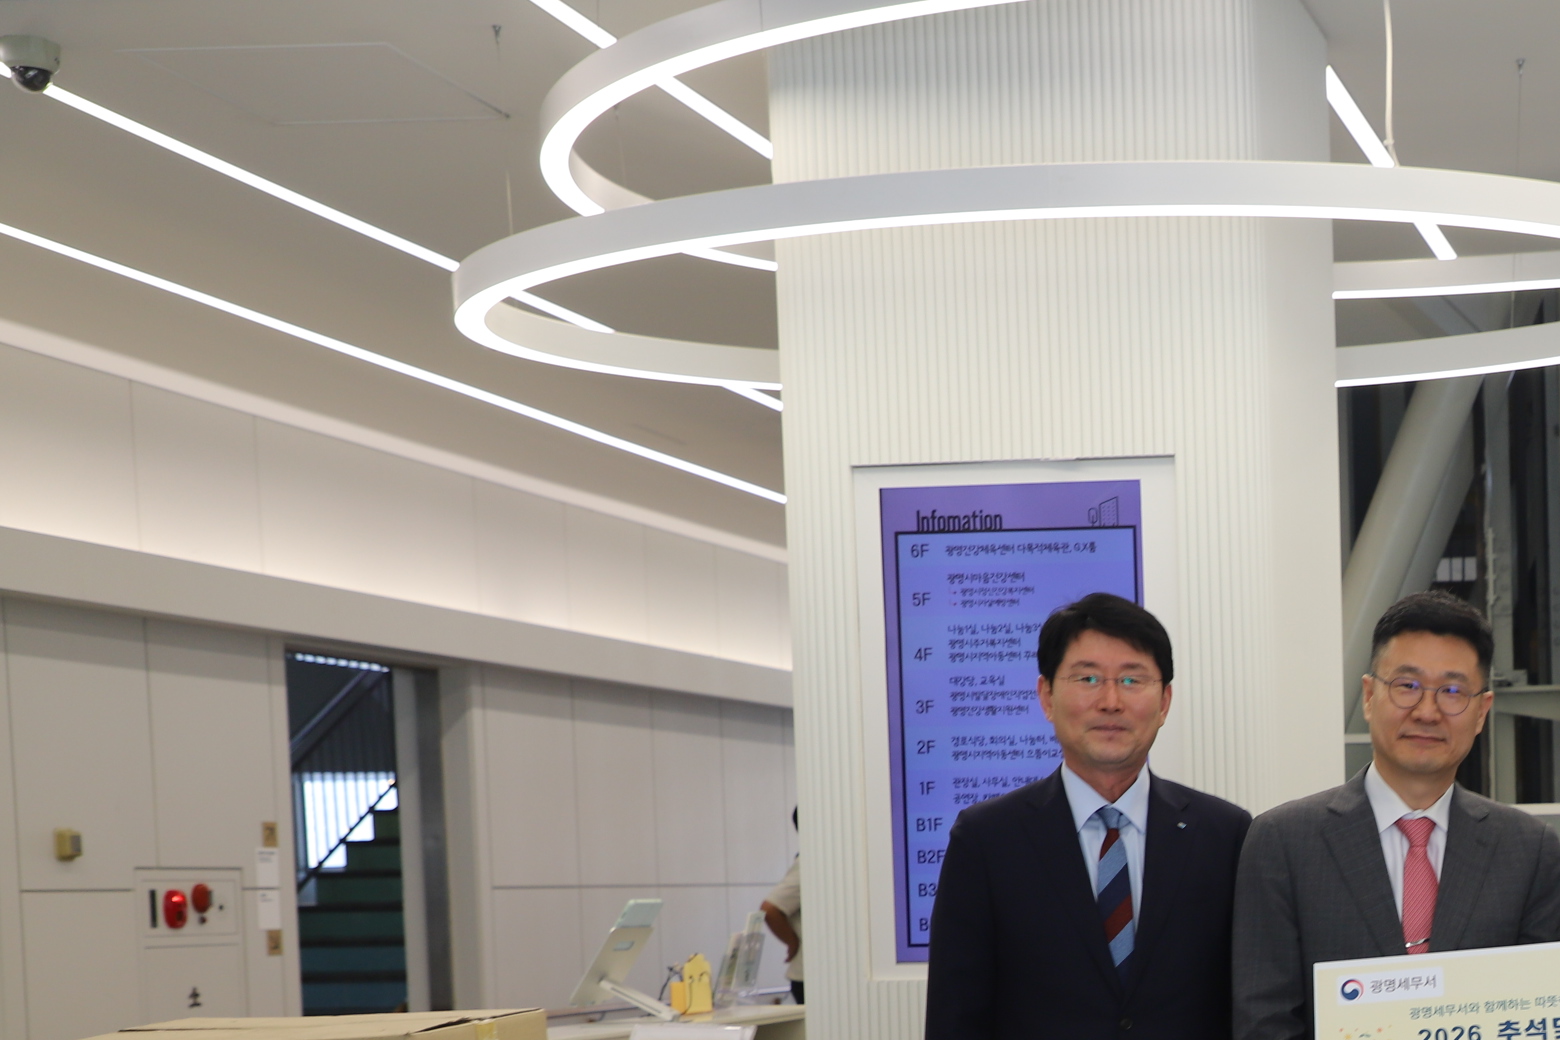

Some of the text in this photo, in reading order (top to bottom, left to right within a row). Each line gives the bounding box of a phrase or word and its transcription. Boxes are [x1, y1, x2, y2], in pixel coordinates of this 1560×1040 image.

[916, 509, 1003, 531] Infomation
[911, 543, 929, 558] 6F
[913, 592, 931, 607] 5F
[914, 647, 933, 661] 4F
[916, 700, 935, 714] 3F
[916, 740, 936, 755] 2F
[919, 781, 935, 796] 1F
[916, 817, 943, 832] B1F
[917, 849, 945, 864] B2F
[1370, 974, 1437, 994] 광명세무서
[1409, 1002, 1480, 1021] 광명세무서와
[1483, 997, 1531, 1015] 함께하는
